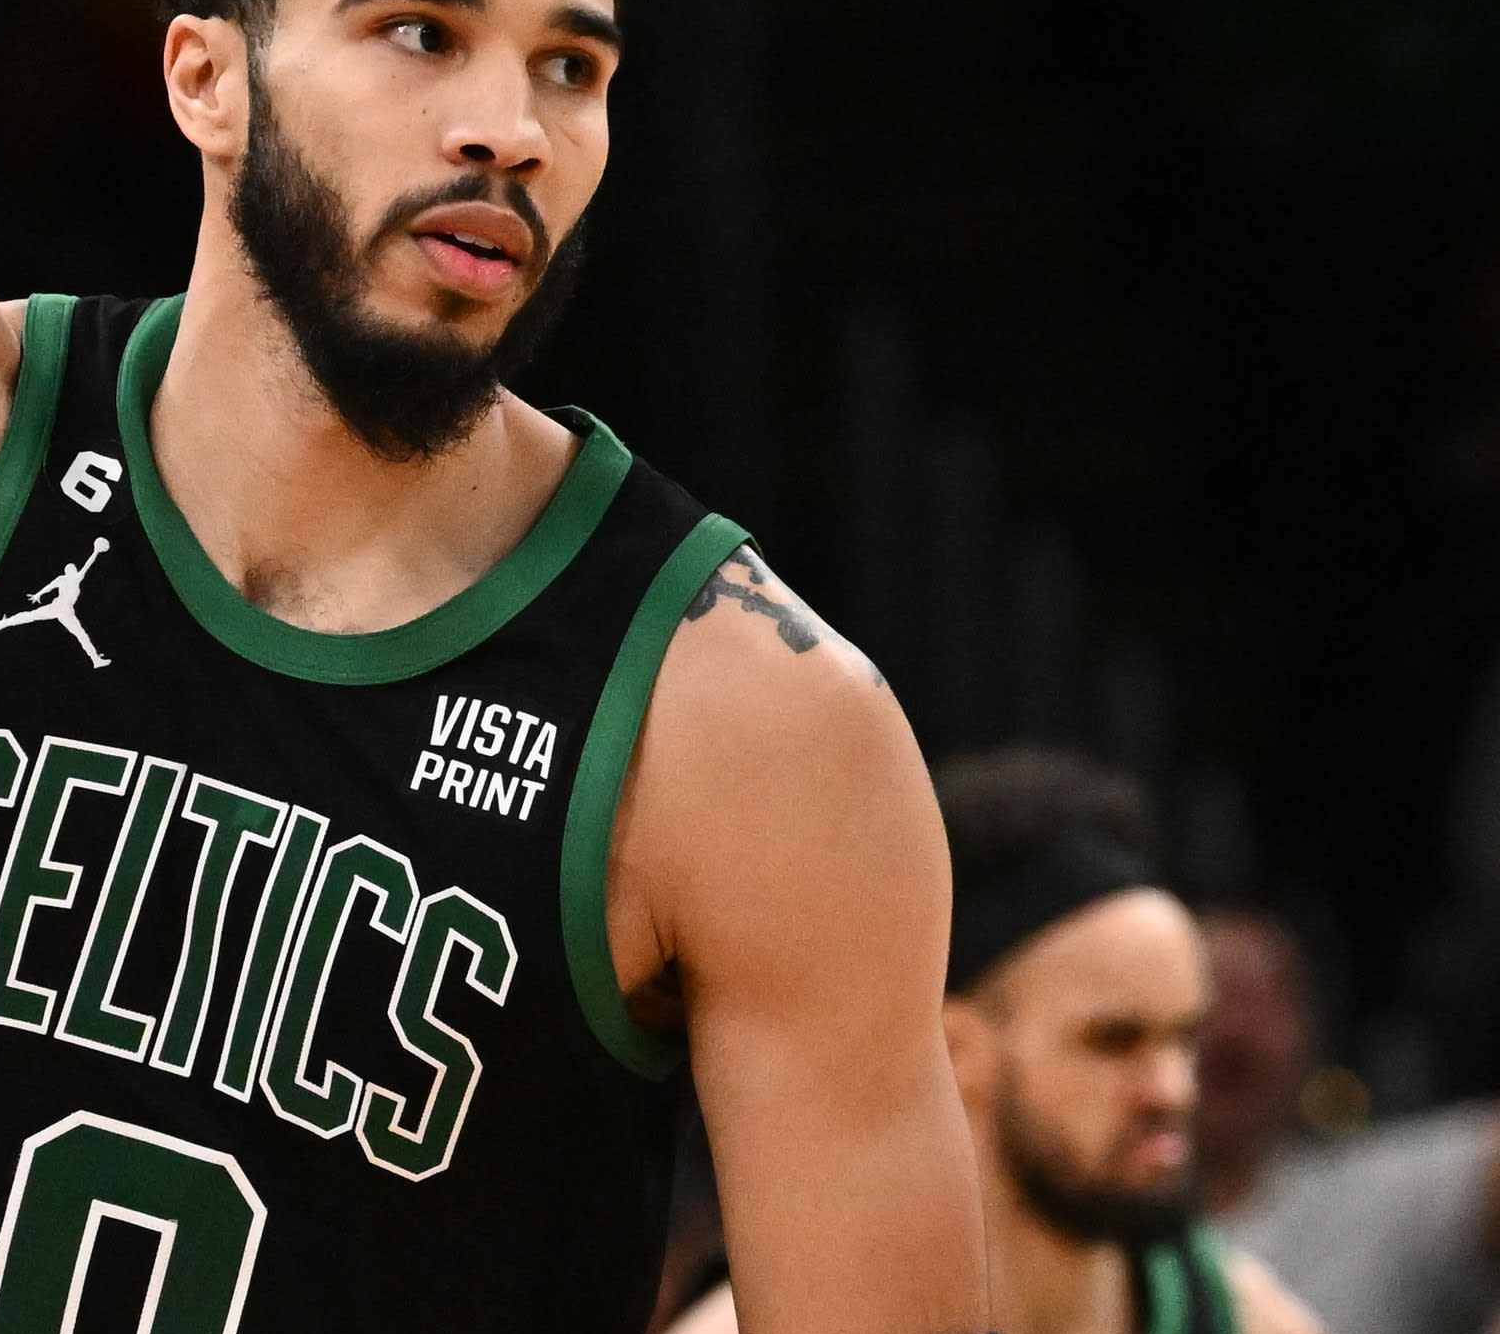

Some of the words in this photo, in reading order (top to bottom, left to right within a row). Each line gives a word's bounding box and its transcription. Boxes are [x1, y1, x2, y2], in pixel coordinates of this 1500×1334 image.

[60, 450, 123, 513] 6
[430, 695, 558, 779] VISTA
[410, 750, 546, 821] PRINT
